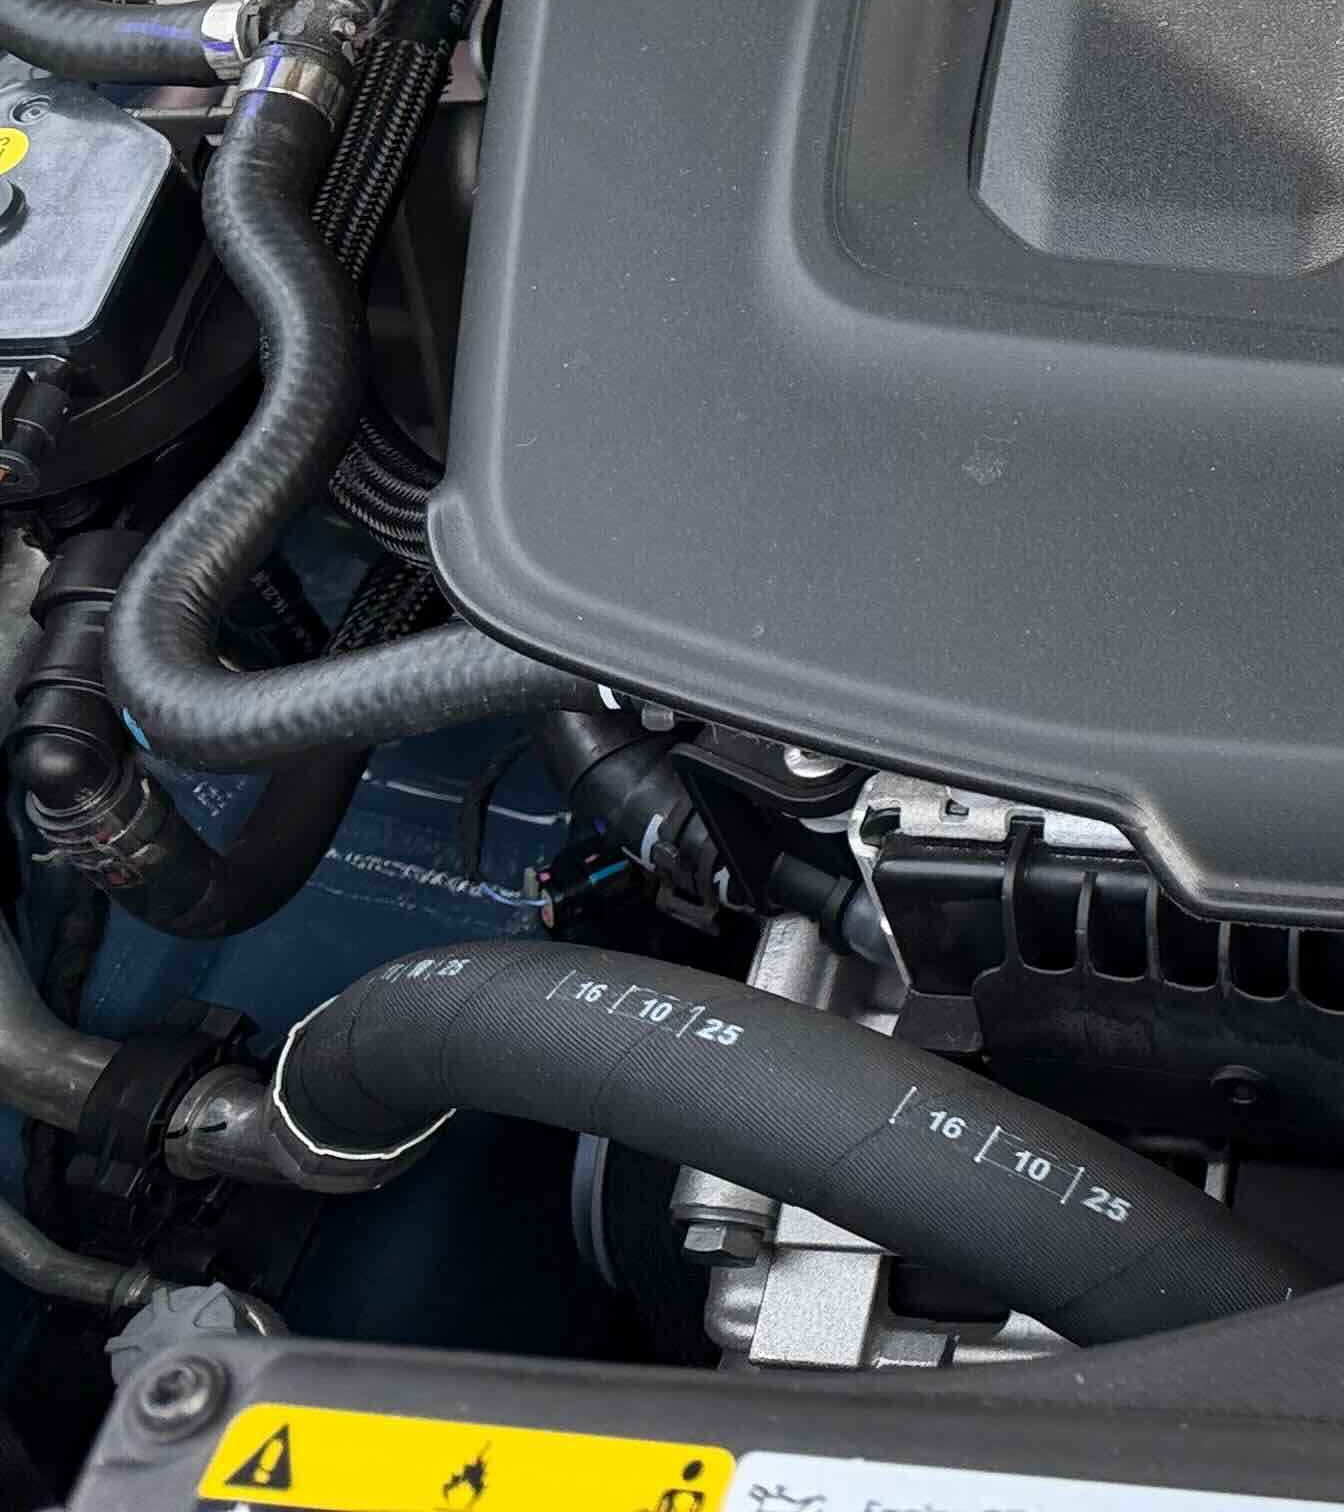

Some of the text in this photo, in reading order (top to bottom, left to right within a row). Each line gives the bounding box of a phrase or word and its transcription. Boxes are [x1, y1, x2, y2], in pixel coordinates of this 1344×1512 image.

[574, 981, 745, 1047] 16 10 25
[927, 1109, 1133, 1224] 16 10 25
